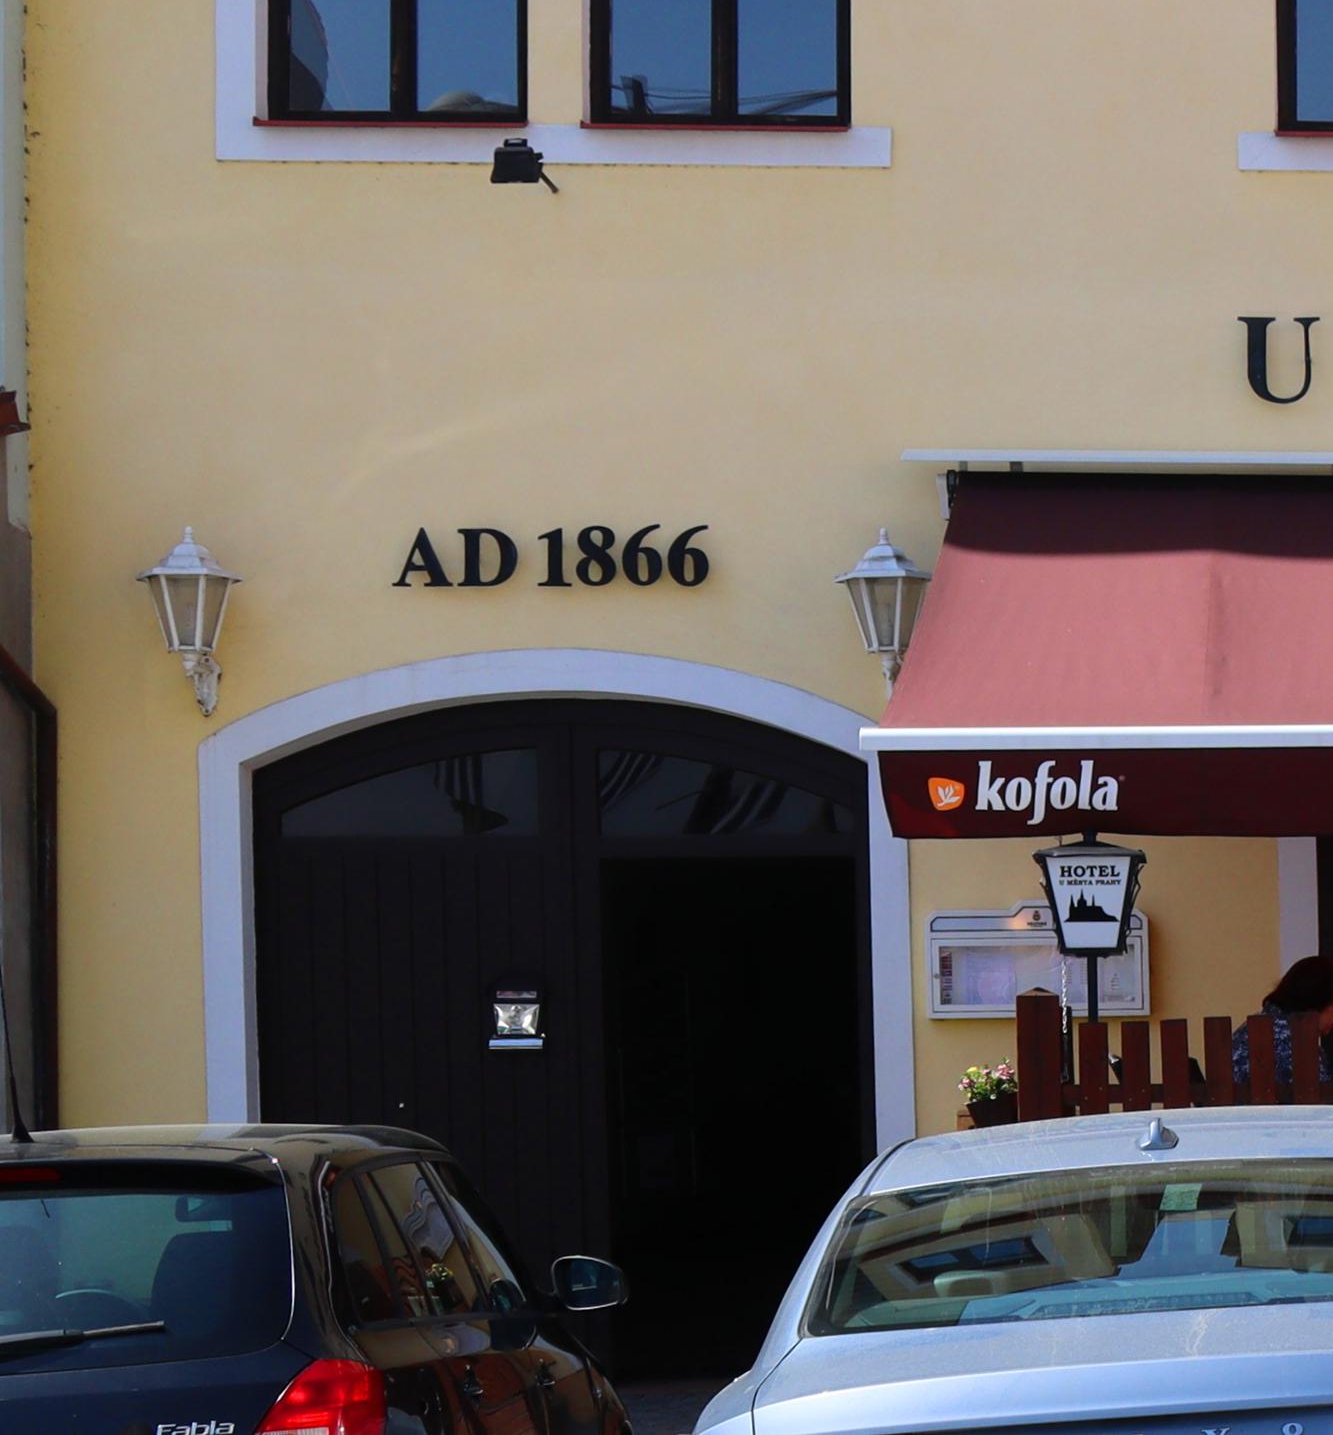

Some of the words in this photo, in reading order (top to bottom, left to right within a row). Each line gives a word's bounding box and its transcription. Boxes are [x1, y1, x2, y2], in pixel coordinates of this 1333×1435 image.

[1237, 316, 1320, 404] U
[392, 527, 519, 587] AD
[537, 524, 710, 587] 1866
[975, 759, 1120, 826] kofola
[1060, 865, 1121, 878] HOTEL
